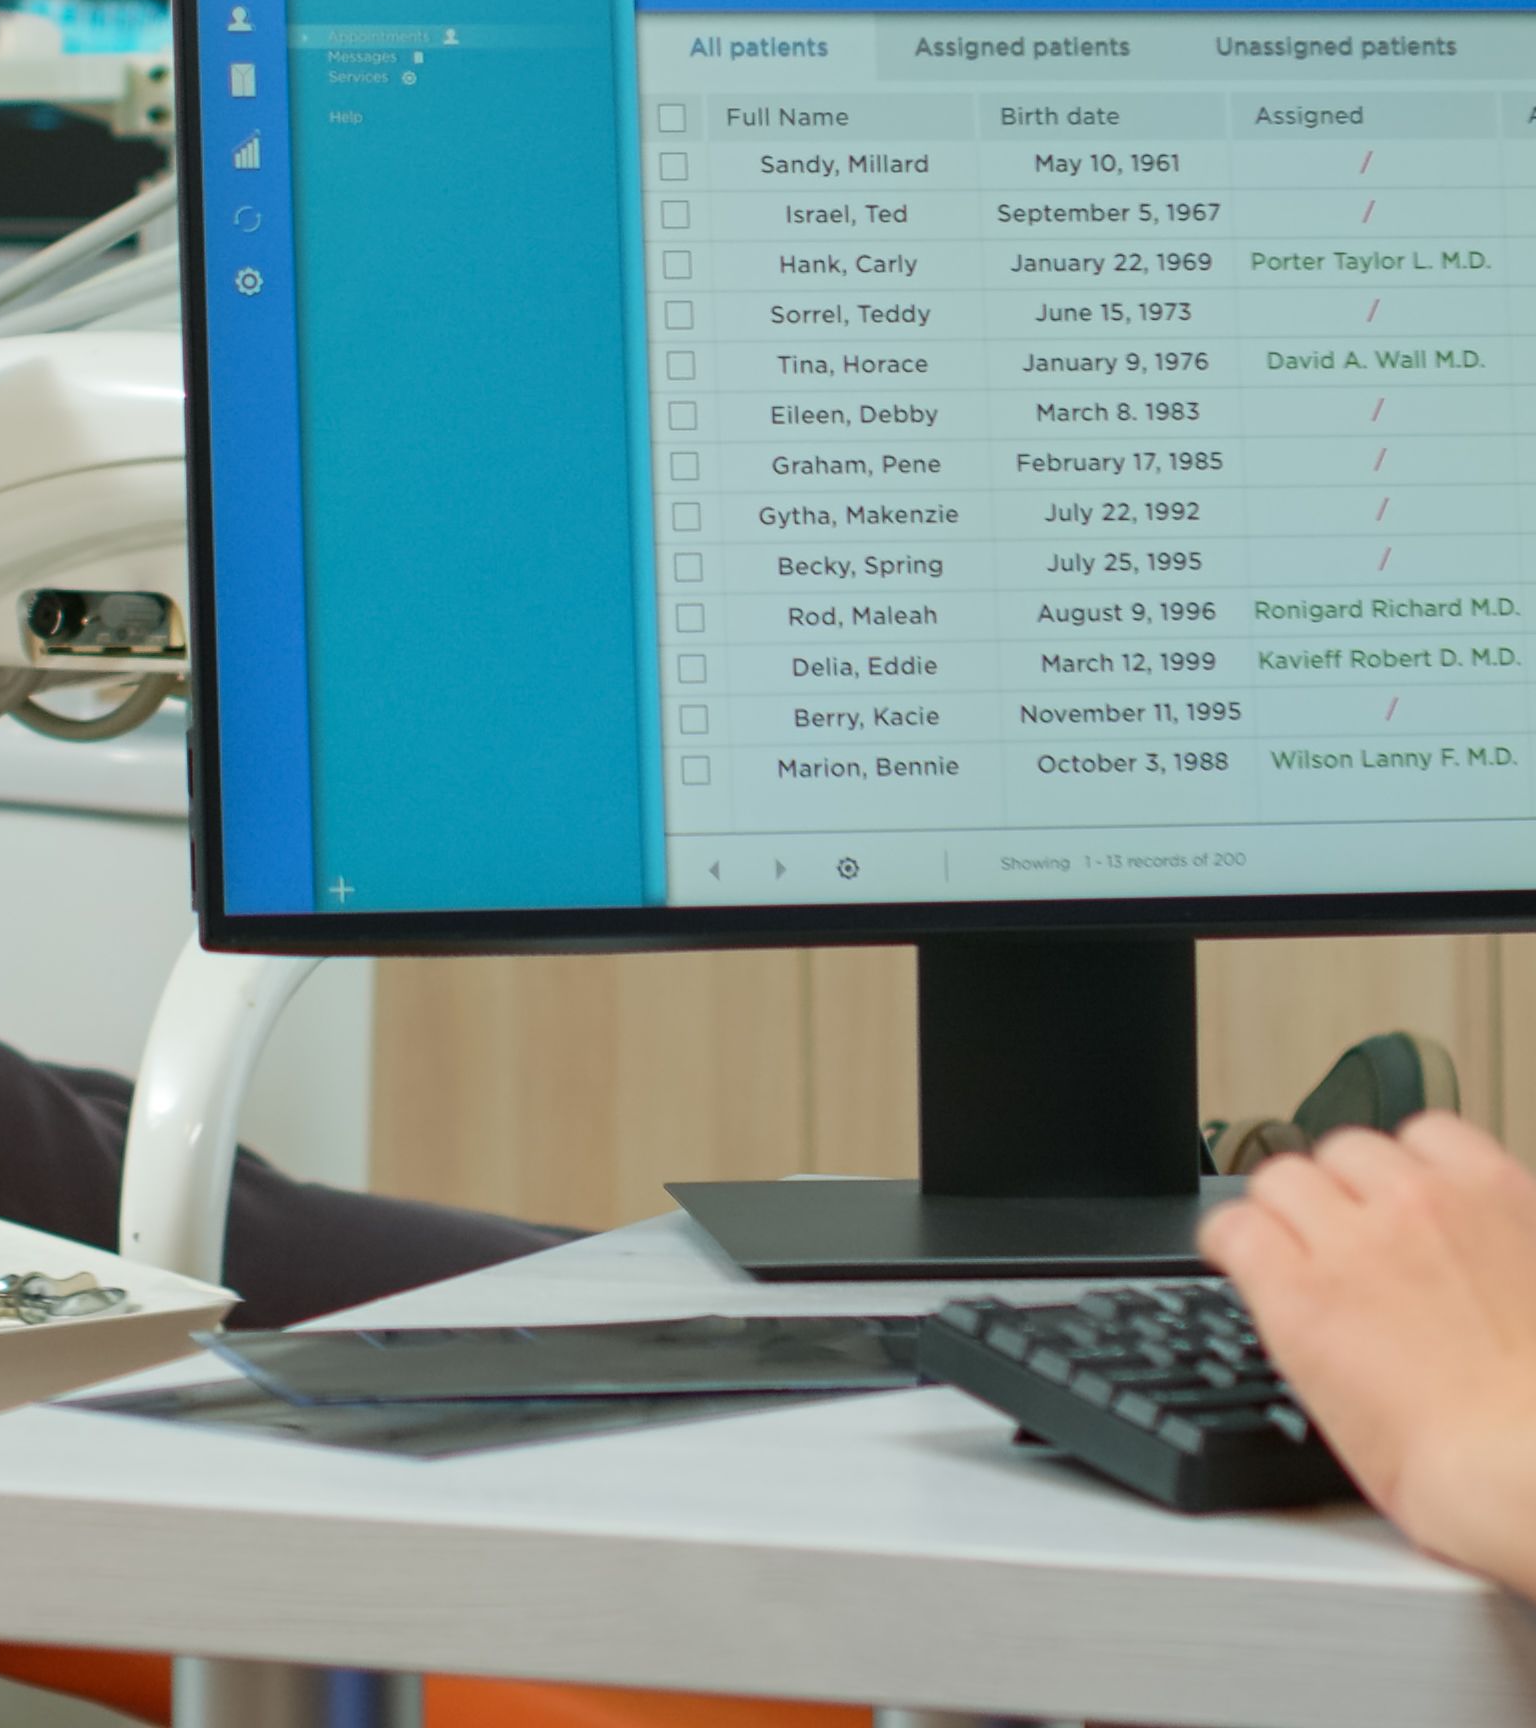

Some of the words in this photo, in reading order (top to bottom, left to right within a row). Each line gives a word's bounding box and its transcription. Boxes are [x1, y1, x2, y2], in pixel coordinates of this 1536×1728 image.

[328, 50, 398, 66] Messages
[689, 36, 722, 57] All
[729, 36, 829, 61] patients
[914, 36, 1025, 61] Assigned
[1032, 36, 1131, 61] patients
[1215, 35, 1354, 61] Unassigned
[1361, 35, 1458, 60] patients
[328, 71, 389, 84] Services
[329, 110, 364, 126] Help
[726, 106, 770, 127] Full
[779, 107, 849, 127] Name
[1000, 106, 1059, 126] Birth
[1066, 106, 1120, 126] date
[1255, 105, 1364, 129] Assigned
[760, 154, 840, 178] Sandy,
[848, 153, 929, 174] Millard
[1035, 153, 1083, 177] May
[1089, 153, 1123, 176] 10,
[1130, 153, 1180, 173] 1961
[786, 204, 857, 227] Israel,
[864, 203, 908, 224] Ted
[997, 202, 1131, 227] September
[1138, 202, 1160, 225] 5,
[1165, 202, 1222, 222] 1967
[779, 253, 848, 277] Hank,
[855, 253, 918, 278] Carly
[1009, 253, 1106, 276] January
[1113, 252, 1149, 275] 22,
[1155, 251, 1213, 272] 1969
[1251, 251, 1326, 272] Porter
[1332, 251, 1406, 275] Taylor
[1412, 251, 1433, 270] L.
[1441, 250, 1492, 270] M.D.
[770, 303, 850, 327] Sorrel,
[856, 303, 932, 328] Teddy
[1034, 303, 1093, 323] June
[1099, 302, 1132, 325] 15,
[1137, 301, 1192, 322] 1973
[776, 355, 835, 377] Tina,
[843, 354, 929, 374] Horace
[1021, 353, 1119, 376] January
[1124, 351, 1148, 375] 9,
[1154, 351, 1210, 372] 1976
[1266, 350, 1335, 371] David
[1343, 350, 1368, 369] A.
[1374, 349, 1427, 369] Wall
[1434, 349, 1486, 369] M.D.
[770, 404, 852, 427] Eileen,
[859, 403, 939, 428] Debby
[1036, 402, 1109, 423] March
[1144, 401, 1201, 422] 1983
[771, 455, 874, 478] Graham,
[881, 454, 942, 475] Pene
[1016, 452, 1126, 476] February
[1132, 451, 1161, 474] 17,
[1168, 451, 1224, 471] 1985
[758, 505, 838, 530] Gytha,
[845, 503, 960, 525] Makenzie
[1044, 502, 1094, 526] July
[1101, 501, 1138, 525] 22,
[1143, 501, 1200, 522] 1992
[777, 555, 857, 580] Becky,
[863, 554, 944, 579] Spring
[1046, 552, 1096, 577] July
[1103, 551, 1140, 575] 25,
[1146, 551, 1203, 572] 1995
[788, 605, 844, 629] Rod,
[852, 604, 938, 626] Maleah
[1036, 603, 1124, 627] August
[1130, 601, 1153, 625] 9,
[1159, 601, 1217, 622] 1996
[1254, 599, 1363, 624] Ronigard
[1371, 597, 1463, 618] Richard
[1470, 597, 1521, 617] M.D.
[792, 656, 860, 680] Delia,
[867, 655, 938, 676] Eddie
[1041, 652, 1115, 674] March
[1120, 652, 1153, 675] 12,
[1159, 651, 1217, 672] 1999
[1258, 649, 1343, 670] Kavieff
[1349, 648, 1433, 669] Robert
[1439, 647, 1464, 668] D.
[1471, 646, 1521, 667] M.D.
[794, 707, 865, 732] Berry,
[873, 705, 940, 727] Kacie
[1020, 703, 1147, 724] November
[1152, 702, 1179, 725] 11,
[1185, 701, 1240, 722] 1995
[777, 757, 868, 780] Marion,
[875, 755, 960, 778] Bennie
[1036, 752, 1138, 775] October
[1145, 752, 1167, 775] 3,
[1172, 751, 1229, 772] 1988
[1270, 749, 1353, 770] Wilson
[1361, 749, 1433, 772] Lanny
[1440, 747, 1460, 767] F.
[1467, 746, 1518, 767] M.D.
[1000, 855, 1072, 874] Showing
[1127, 854, 1189, 869] records
[1192, 852, 1209, 868] of
[1213, 851, 1247, 868] 200
